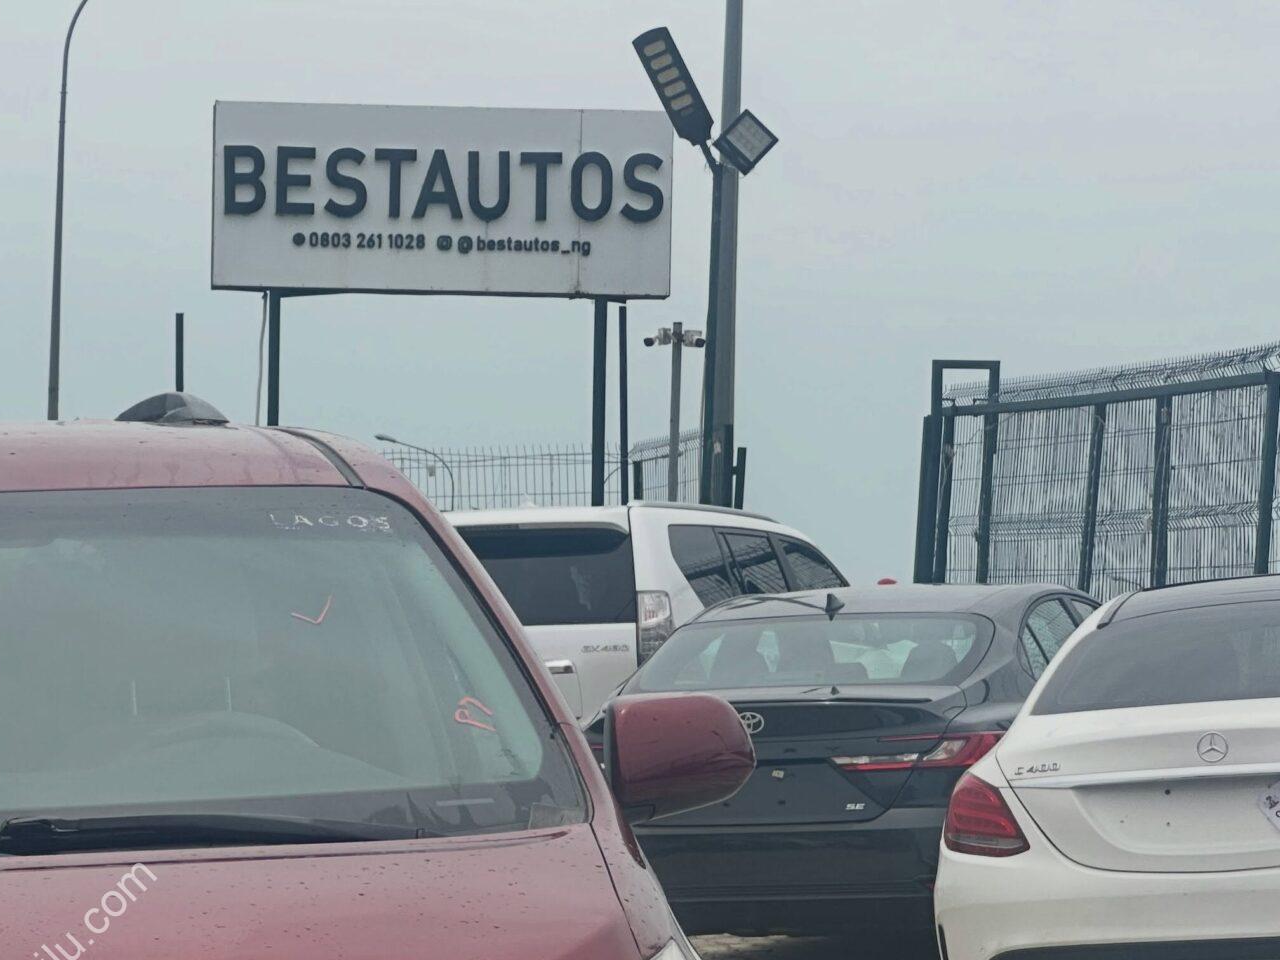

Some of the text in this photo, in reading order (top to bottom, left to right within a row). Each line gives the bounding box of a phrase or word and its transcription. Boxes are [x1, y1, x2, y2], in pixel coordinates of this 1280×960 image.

[223, 144, 665, 223] BESTAUTOS
[309, 231, 352, 248] 0803
[356, 233, 383, 249] 261
[388, 233, 426, 250] 1028
[270, 514, 391, 531] LAGOS
